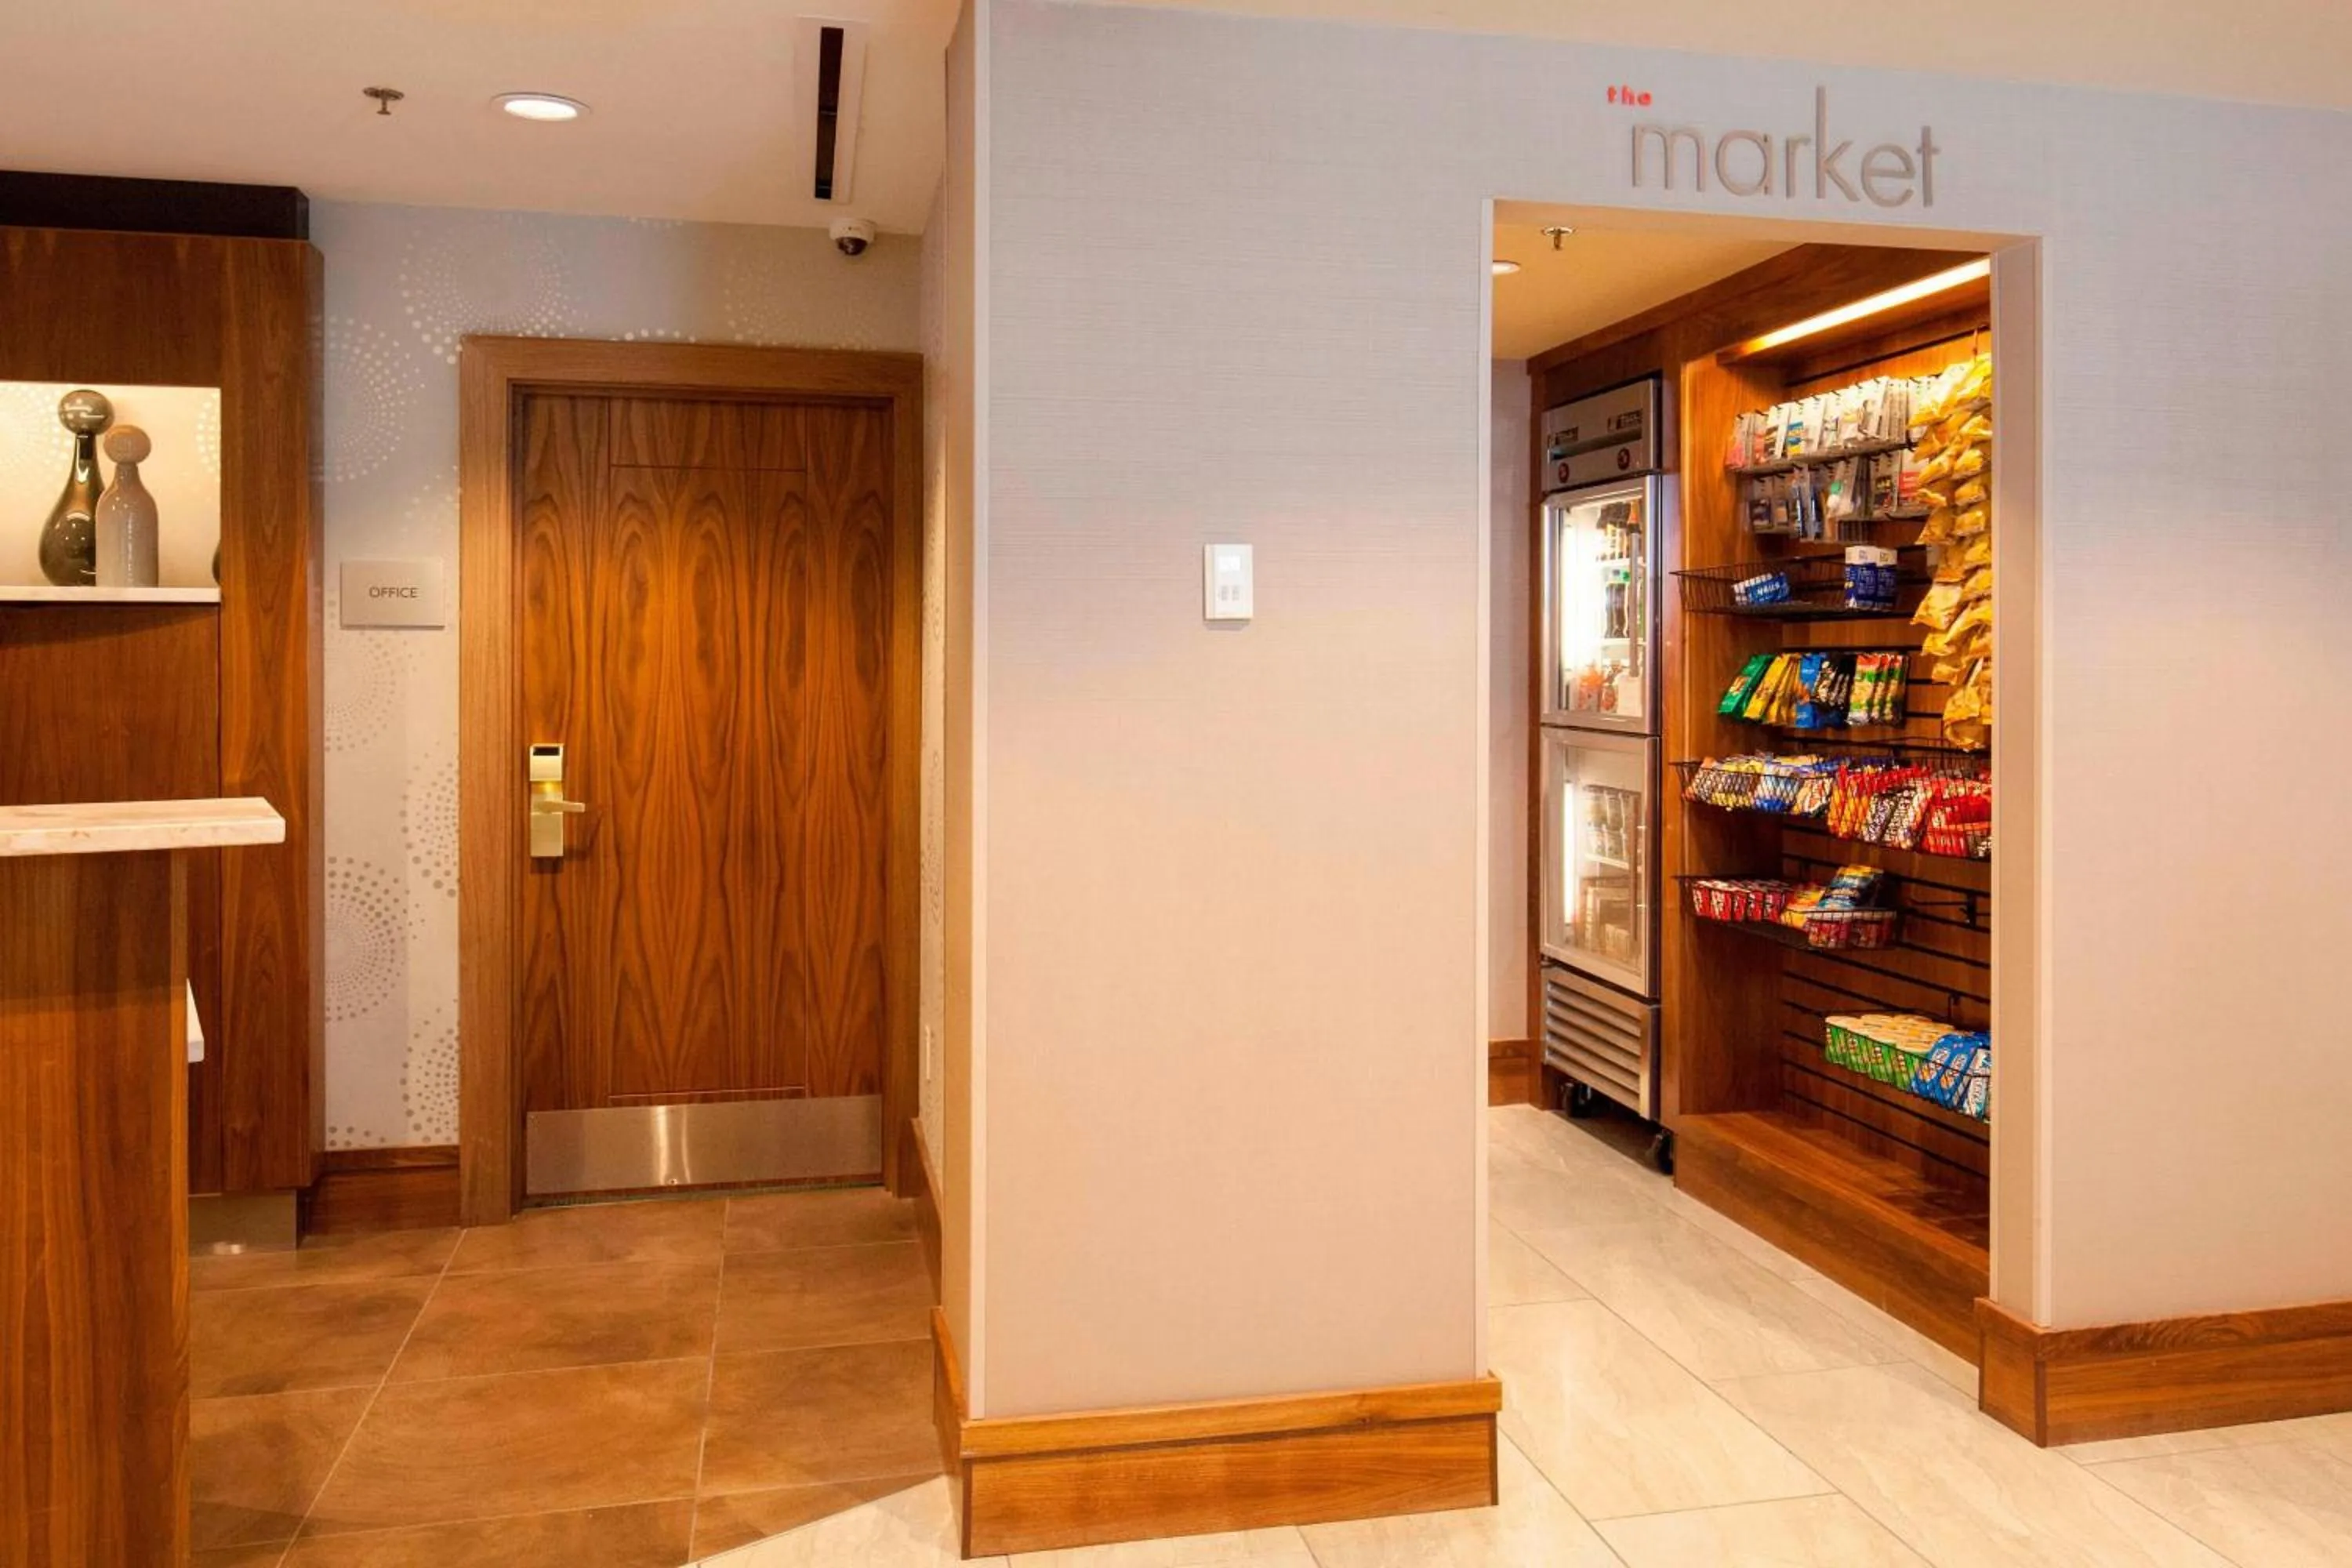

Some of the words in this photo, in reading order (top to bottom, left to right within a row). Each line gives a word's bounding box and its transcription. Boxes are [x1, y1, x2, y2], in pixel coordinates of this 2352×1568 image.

[1606, 85, 1651, 107] the
[1632, 85, 1939, 208] market
[368, 586, 418, 598] OFFICE
